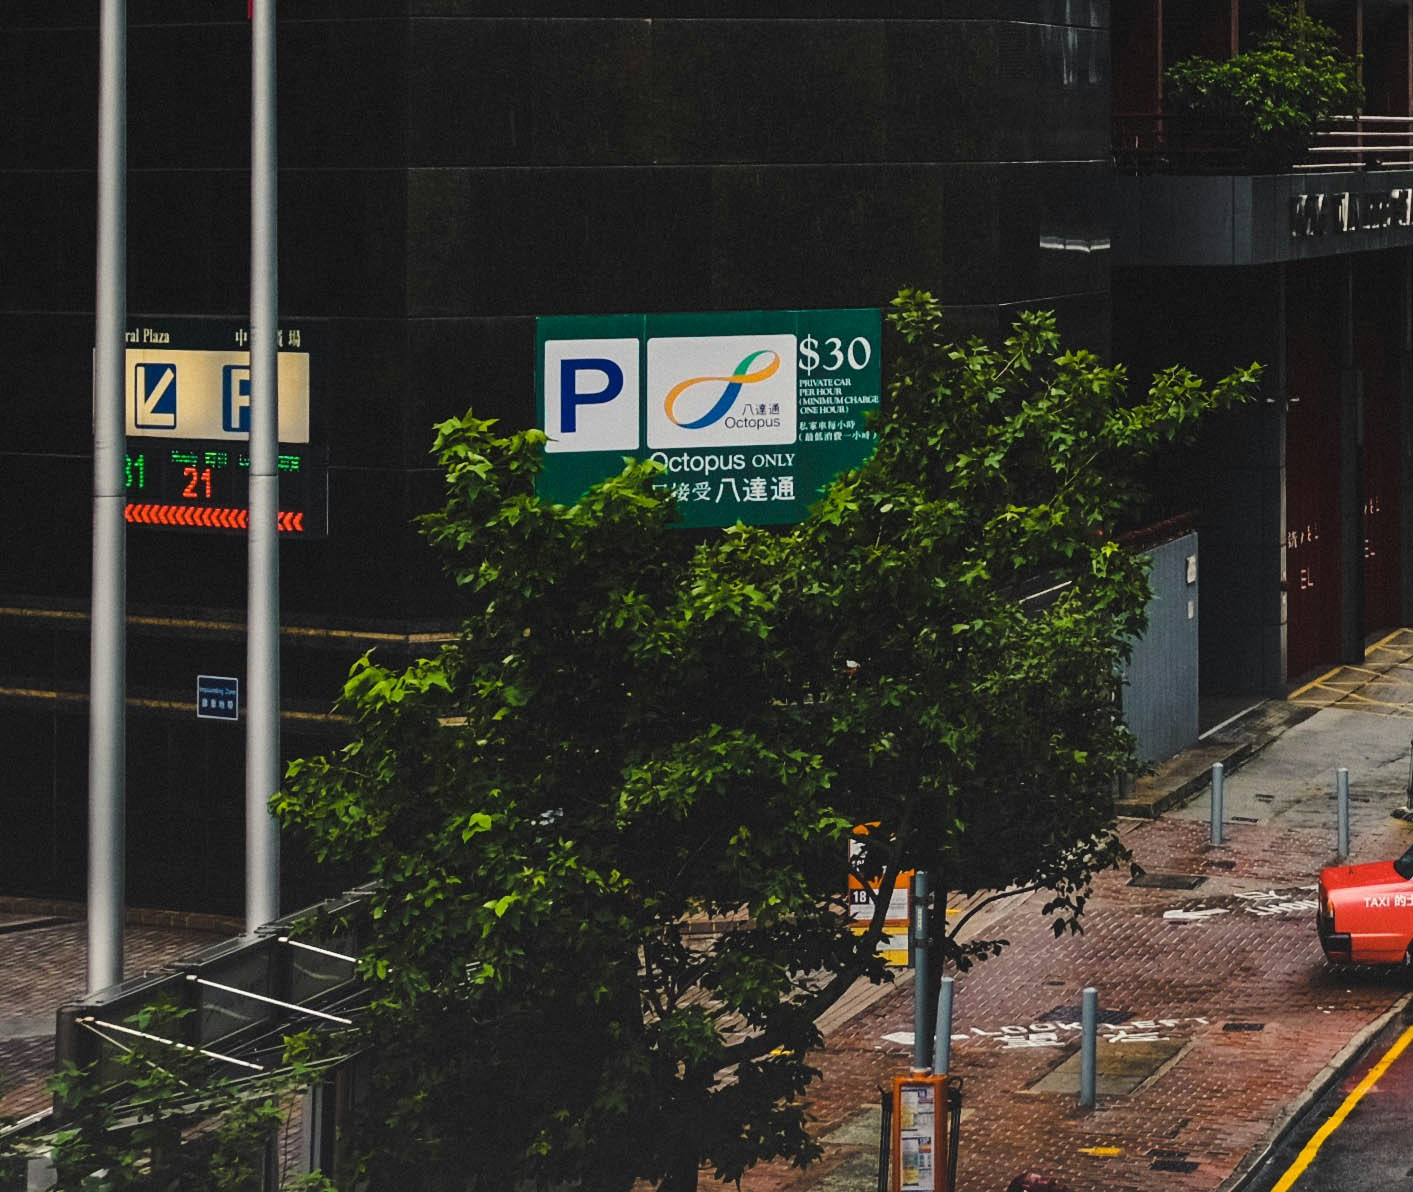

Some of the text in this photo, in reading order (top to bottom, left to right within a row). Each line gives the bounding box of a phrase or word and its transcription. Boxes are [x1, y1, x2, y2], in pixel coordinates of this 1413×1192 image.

[143, 328, 170, 343] Plaza
[798, 334, 871, 376] $30
[799, 378, 851, 387] PRIVATE CAR
[560, 358, 624, 433] P
[800, 388, 842, 396] PER HOUR
[844, 395, 880, 404] CHARGE
[742, 404, 780, 415] 八達通
[800, 406, 849, 414] ONE HOUR)
[724, 416, 781, 430] Octopus
[650, 451, 795, 475] Octopus ONLY
[183, 468, 212, 498] 21
[853, 890, 867, 903] 18
[1363, 896, 1390, 908] TAXI
[970, 1016, 1210, 1037] LOOK LEFT
